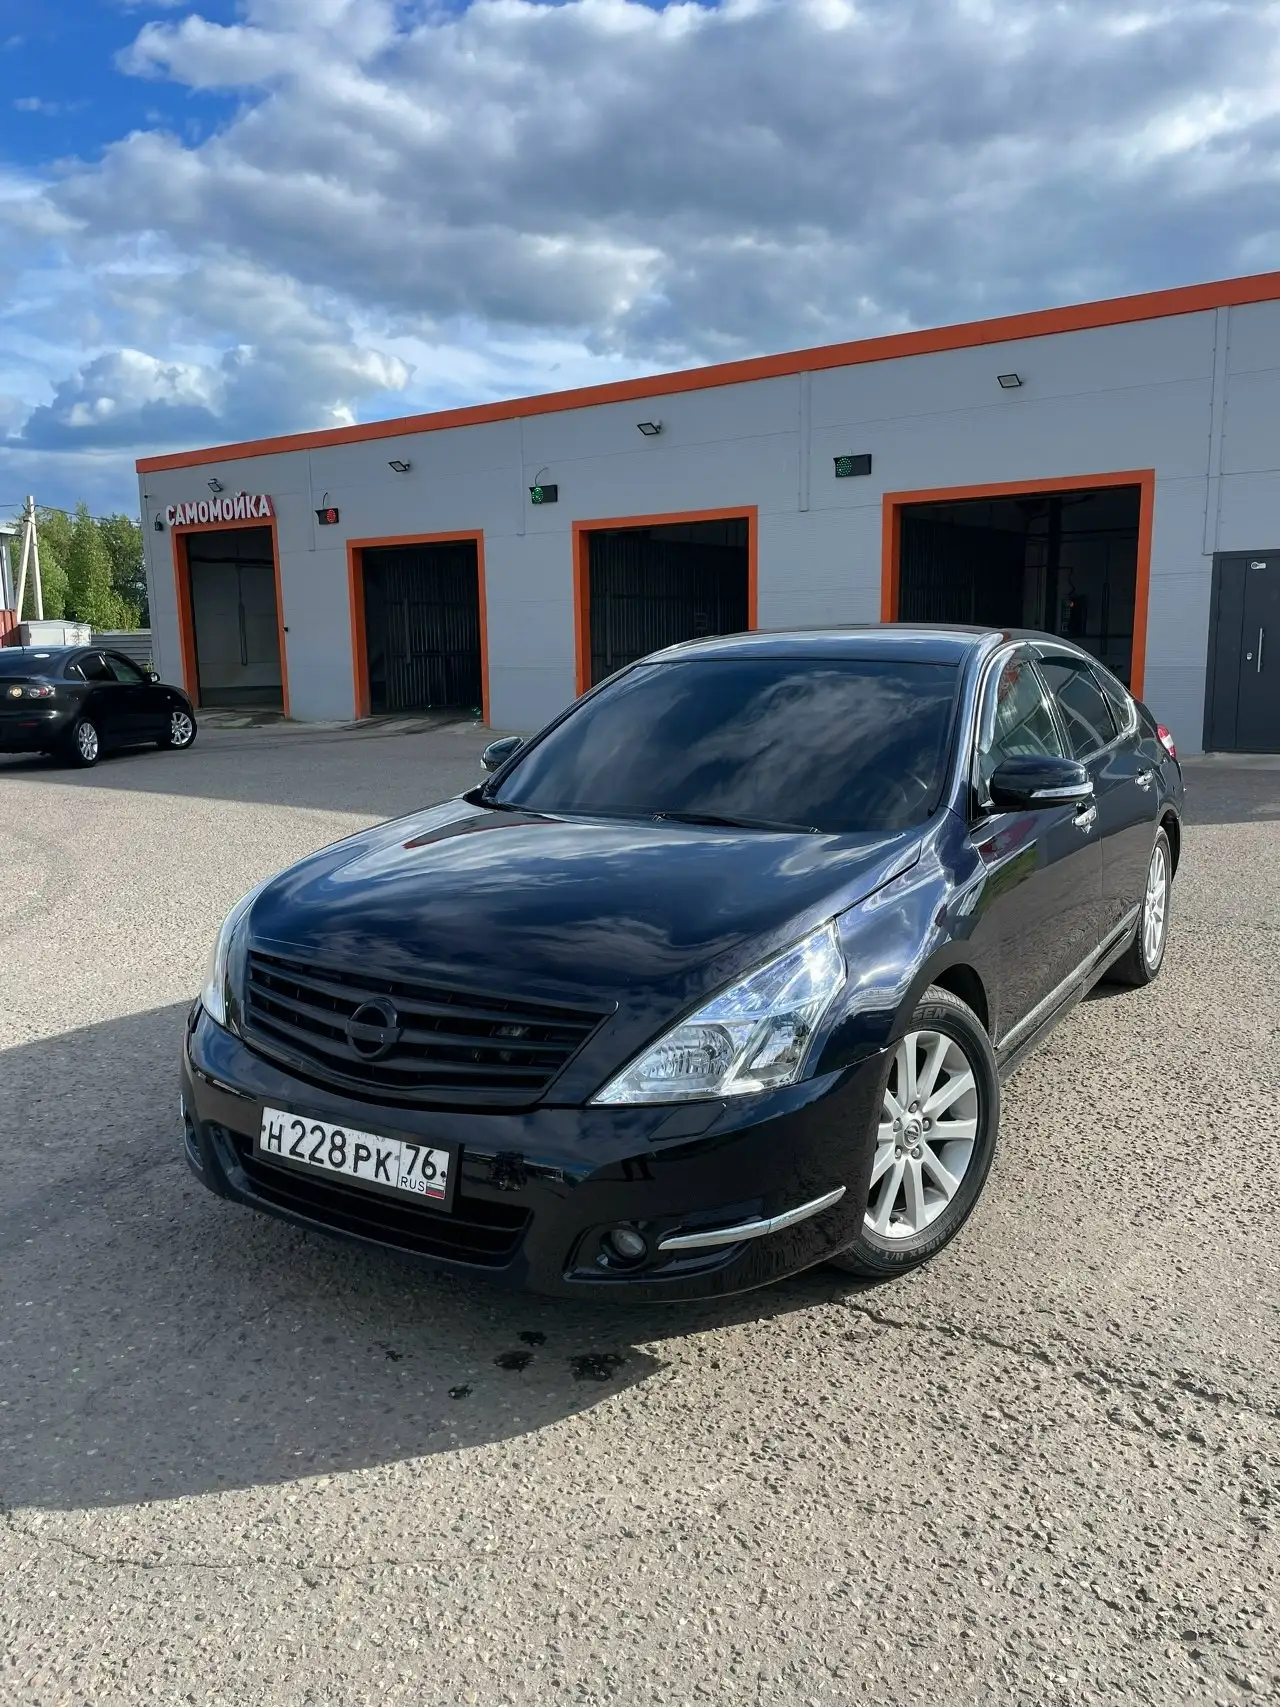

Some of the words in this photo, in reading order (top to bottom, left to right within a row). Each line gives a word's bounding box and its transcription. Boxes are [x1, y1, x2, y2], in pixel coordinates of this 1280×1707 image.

[166, 491, 271, 526] САМОМОЙКА
[912, 1007, 946, 1020] SEN
[405, 1144, 437, 1181] 76
[400, 1176, 425, 1192] RUS
